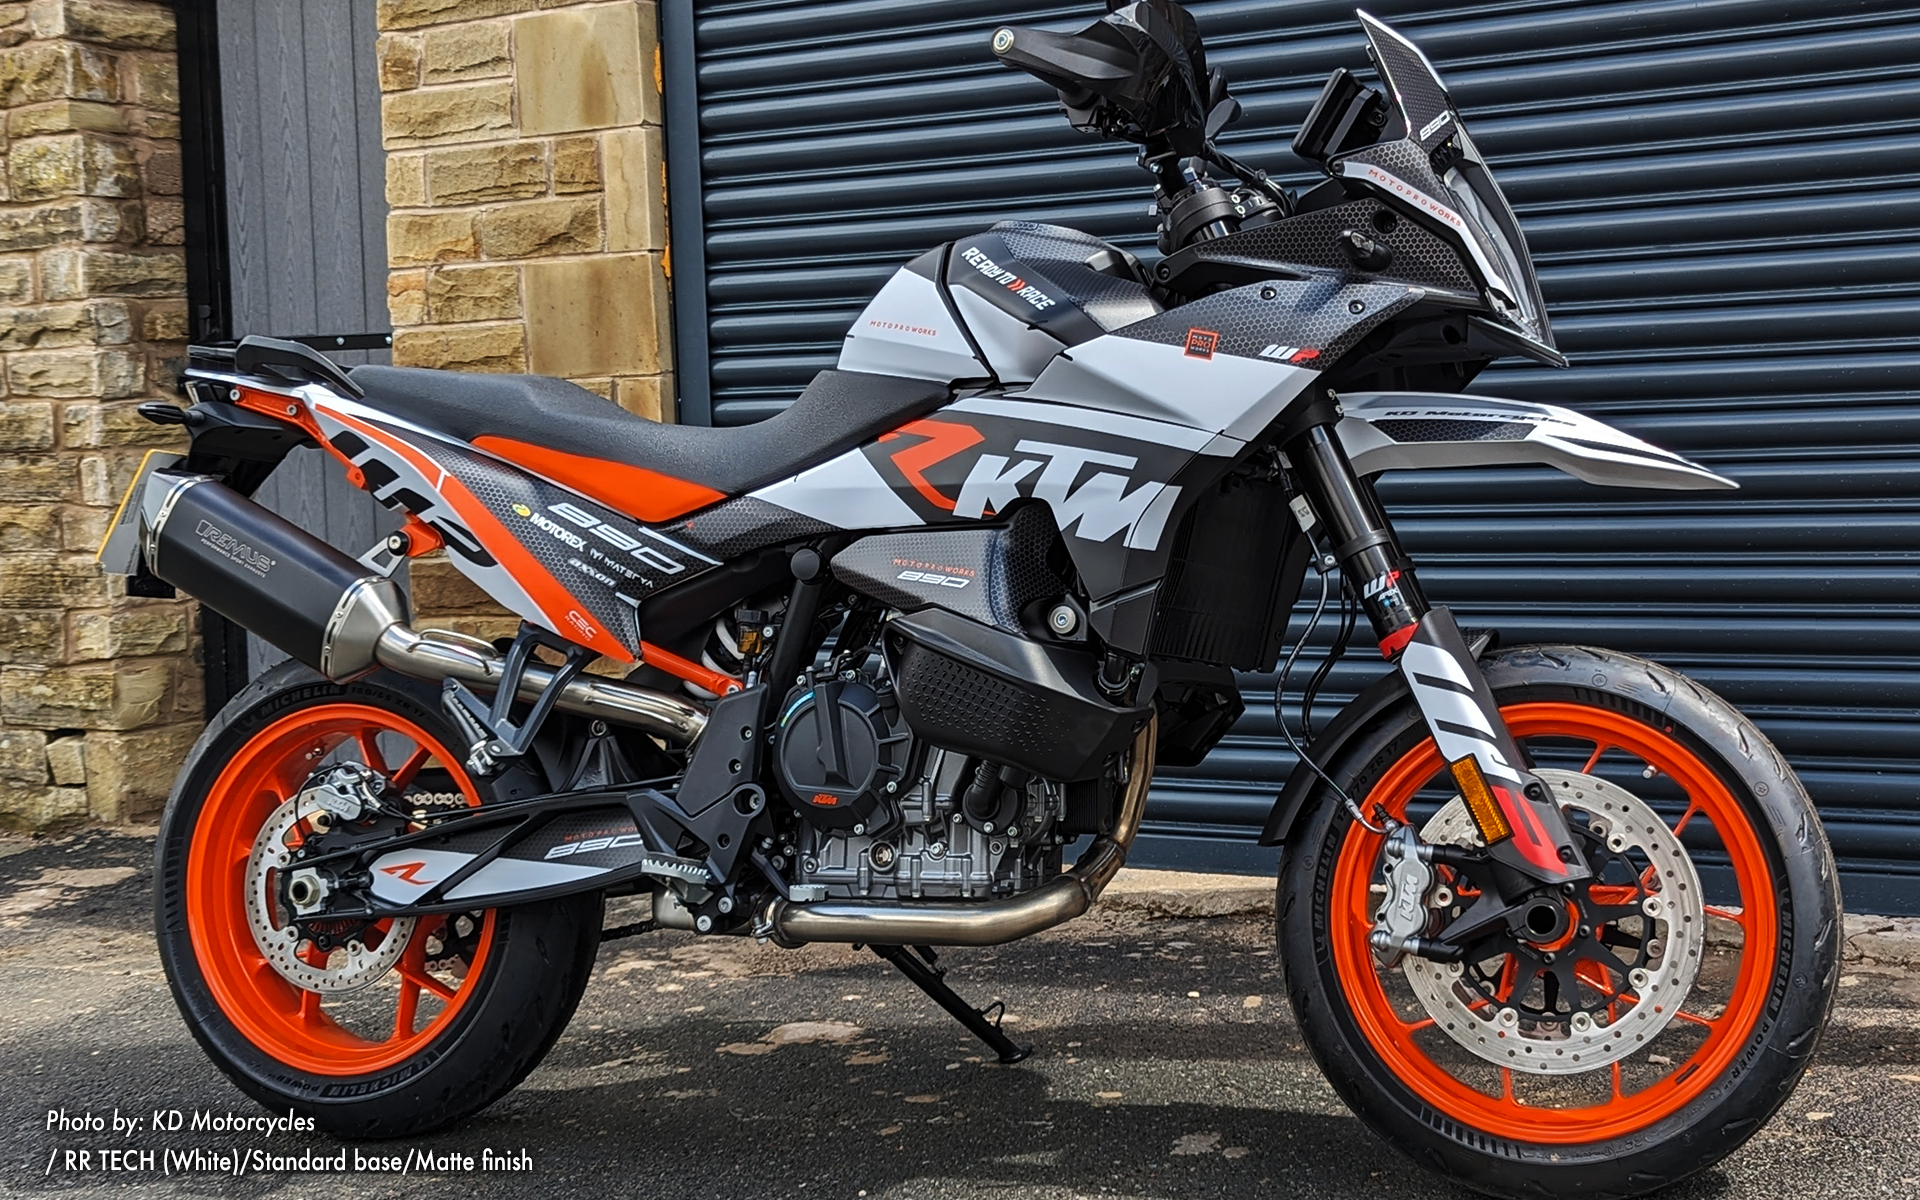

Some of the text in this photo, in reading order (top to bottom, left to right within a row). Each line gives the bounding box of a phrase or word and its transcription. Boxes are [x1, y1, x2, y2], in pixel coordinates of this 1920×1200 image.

[1420, 110, 1451, 141] 890
[1016, 285, 1056, 311] RACE
[1190, 339, 1211, 348] PRO
[1424, 410, 1578, 427] Motorcycles
[952, 439, 1183, 551] KTM
[203, 525, 272, 573] REMUS
[529, 513, 587, 553] MOTOREX
[547, 502, 686, 576] 890
[897, 570, 970, 589] 890
[260, 684, 341, 715] MICHELIN
[1313, 833, 1337, 931] MICHELIN
[1399, 873, 1420, 922] KTM
[1767, 909, 1793, 1014] MICHELIN
[1731, 1022, 1770, 1080] POWER
[276, 1066, 413, 1097] MICHELIN POWER
